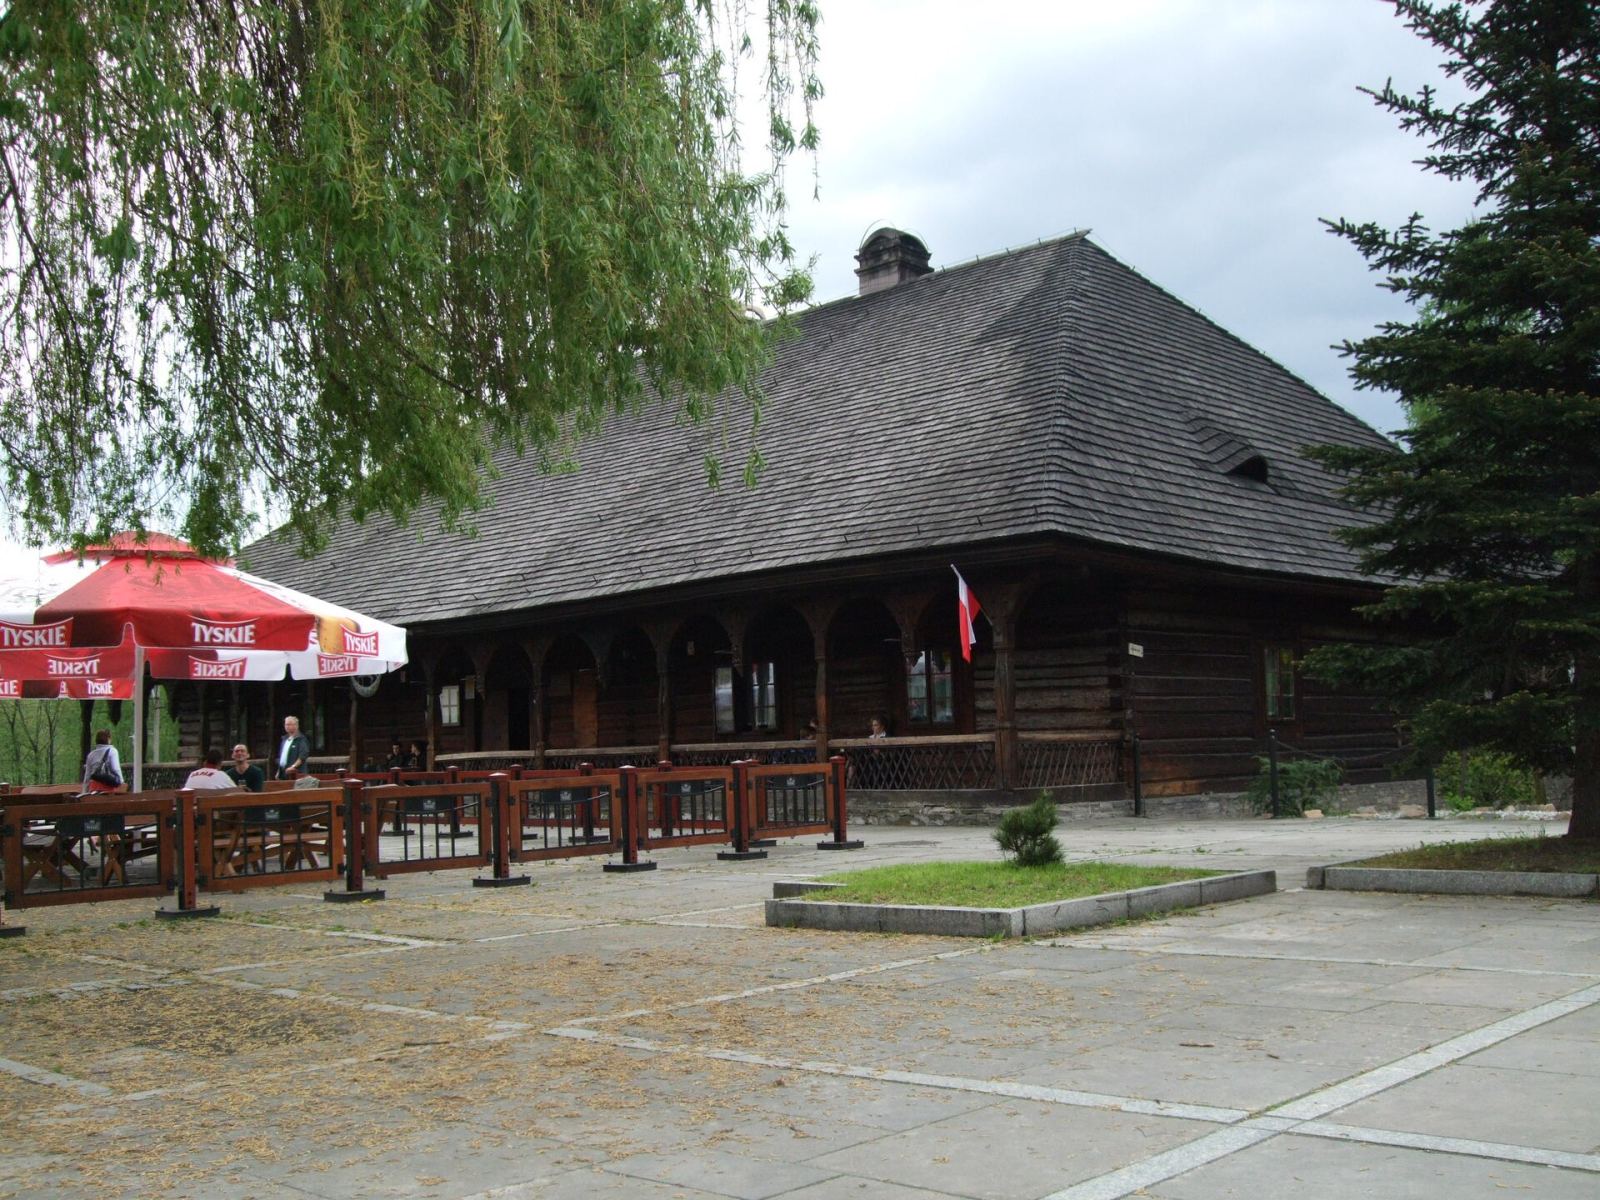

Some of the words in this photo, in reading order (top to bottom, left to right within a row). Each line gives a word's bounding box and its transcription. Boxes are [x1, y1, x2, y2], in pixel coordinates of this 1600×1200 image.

[1, 625, 66, 646] TYSKIE
[191, 622, 256, 644] TYSKIE
[344, 632, 377, 654] TYSKIE
[87, 680, 113, 694] TYSKIE
